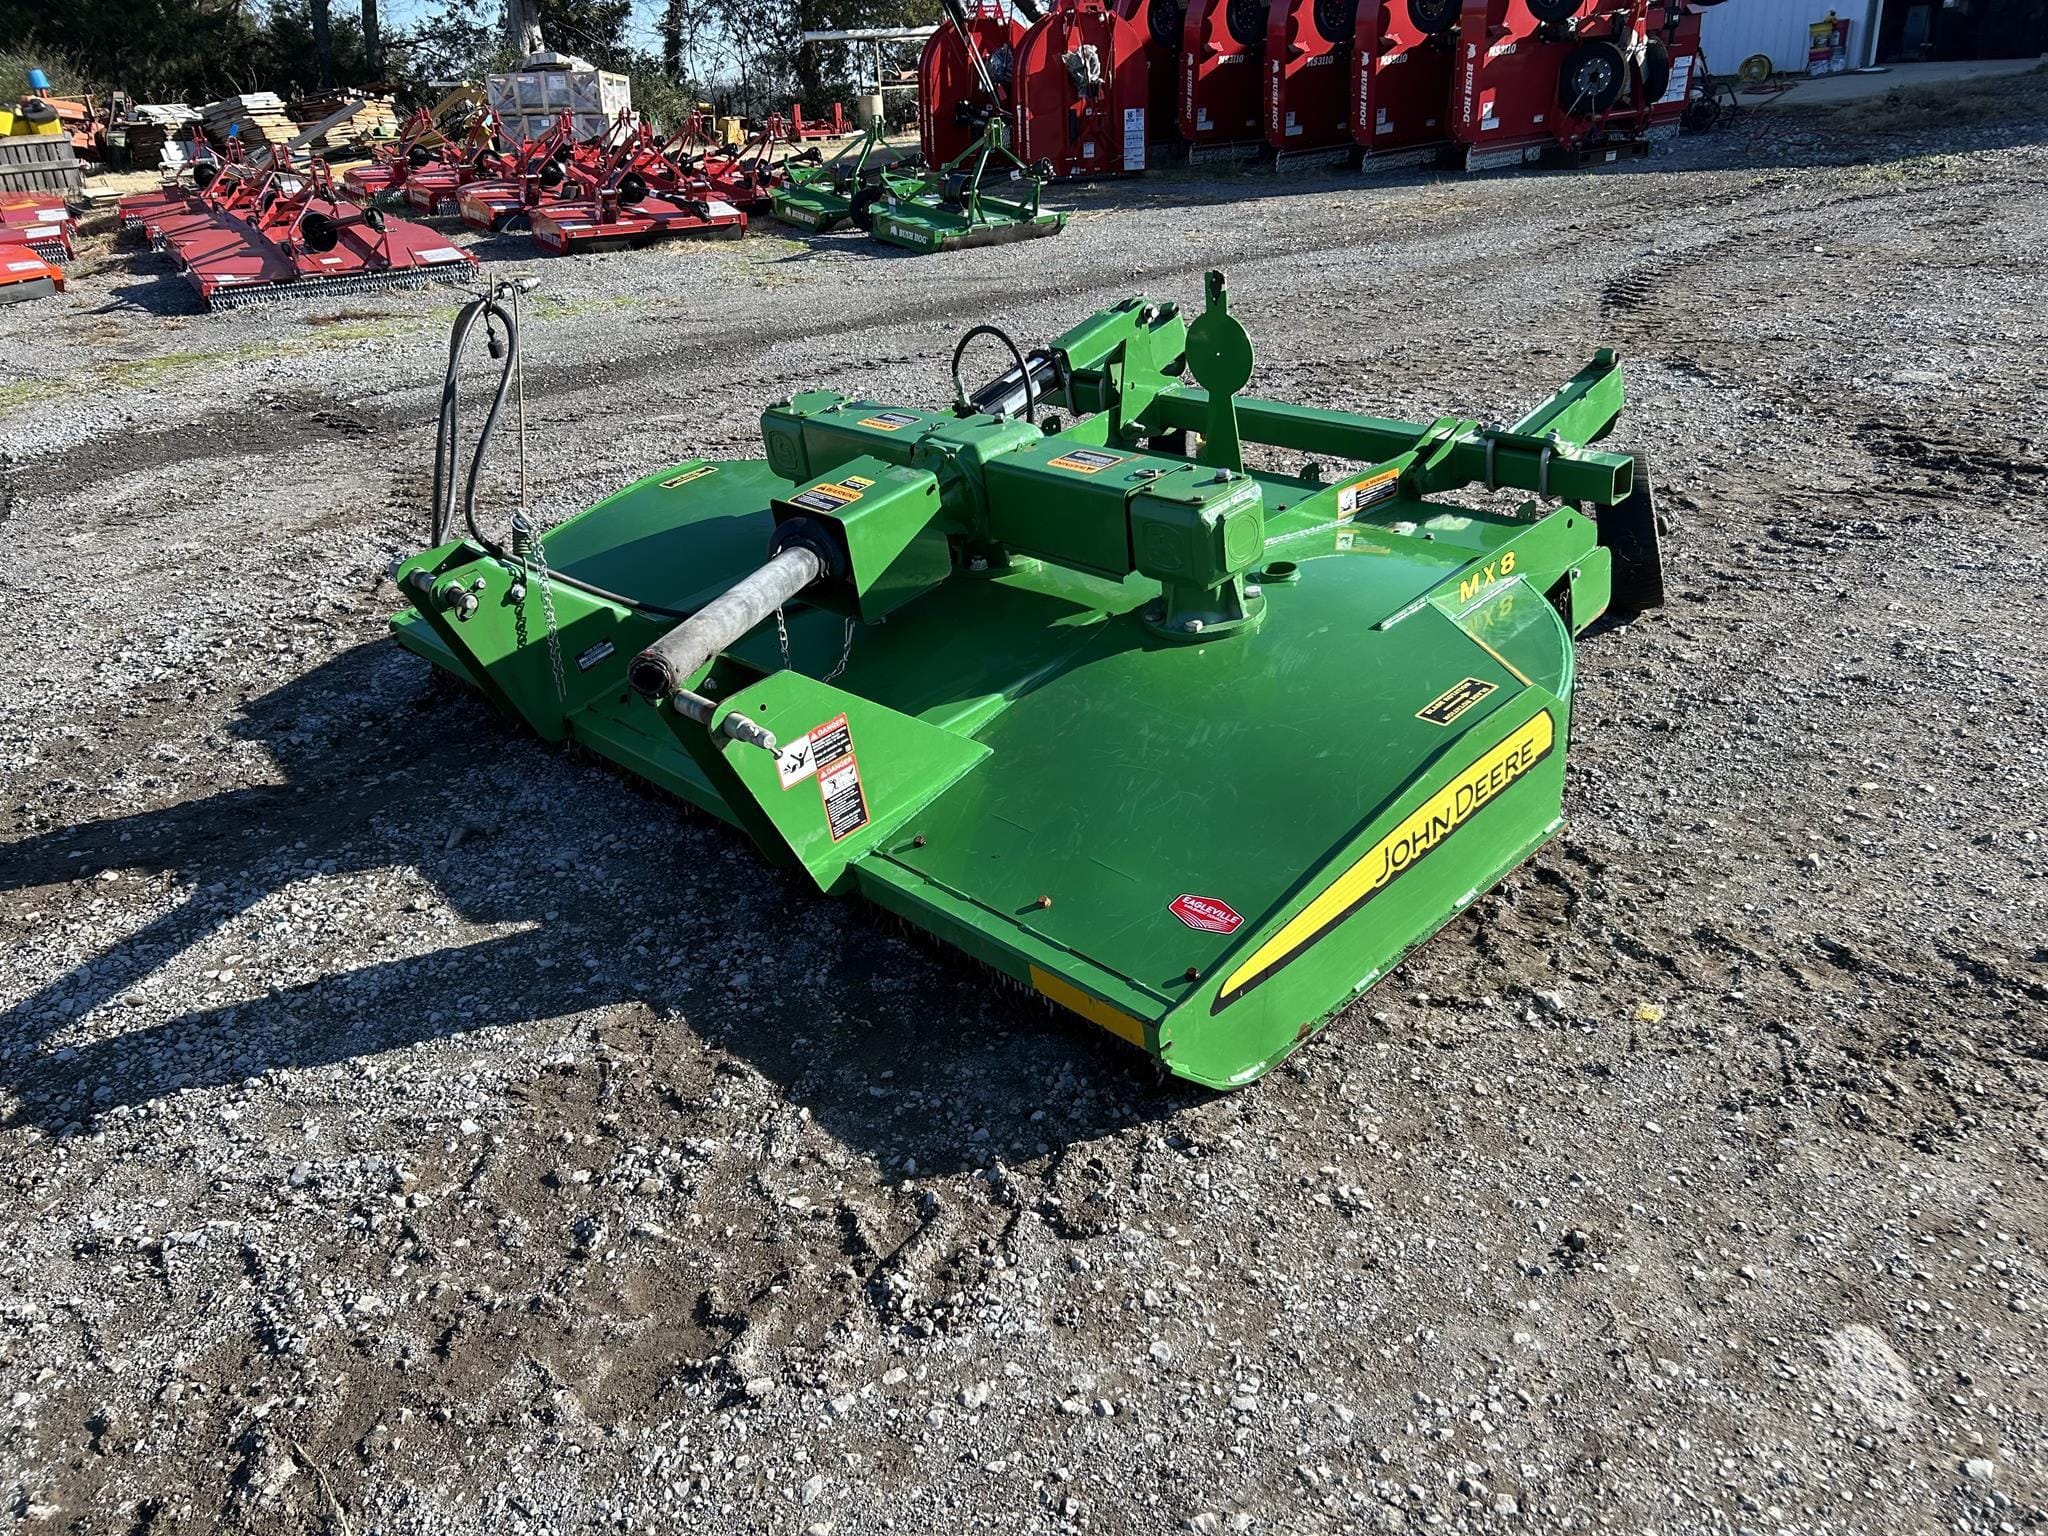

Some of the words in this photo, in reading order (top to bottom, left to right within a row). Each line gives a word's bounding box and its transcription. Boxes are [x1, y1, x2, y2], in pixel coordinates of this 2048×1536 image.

[1465, 63, 1474, 95] BUSH
[1463, 96, 1472, 123] HOG
[898, 229, 914, 241] BUSH
[914, 232, 927, 245] HOG
[817, 717, 845, 735] DANGER
[1375, 807, 1451, 884] JOHN
[1455, 739, 1534, 818] DEERE
[1181, 896, 1240, 924] EAGLEVILLE
